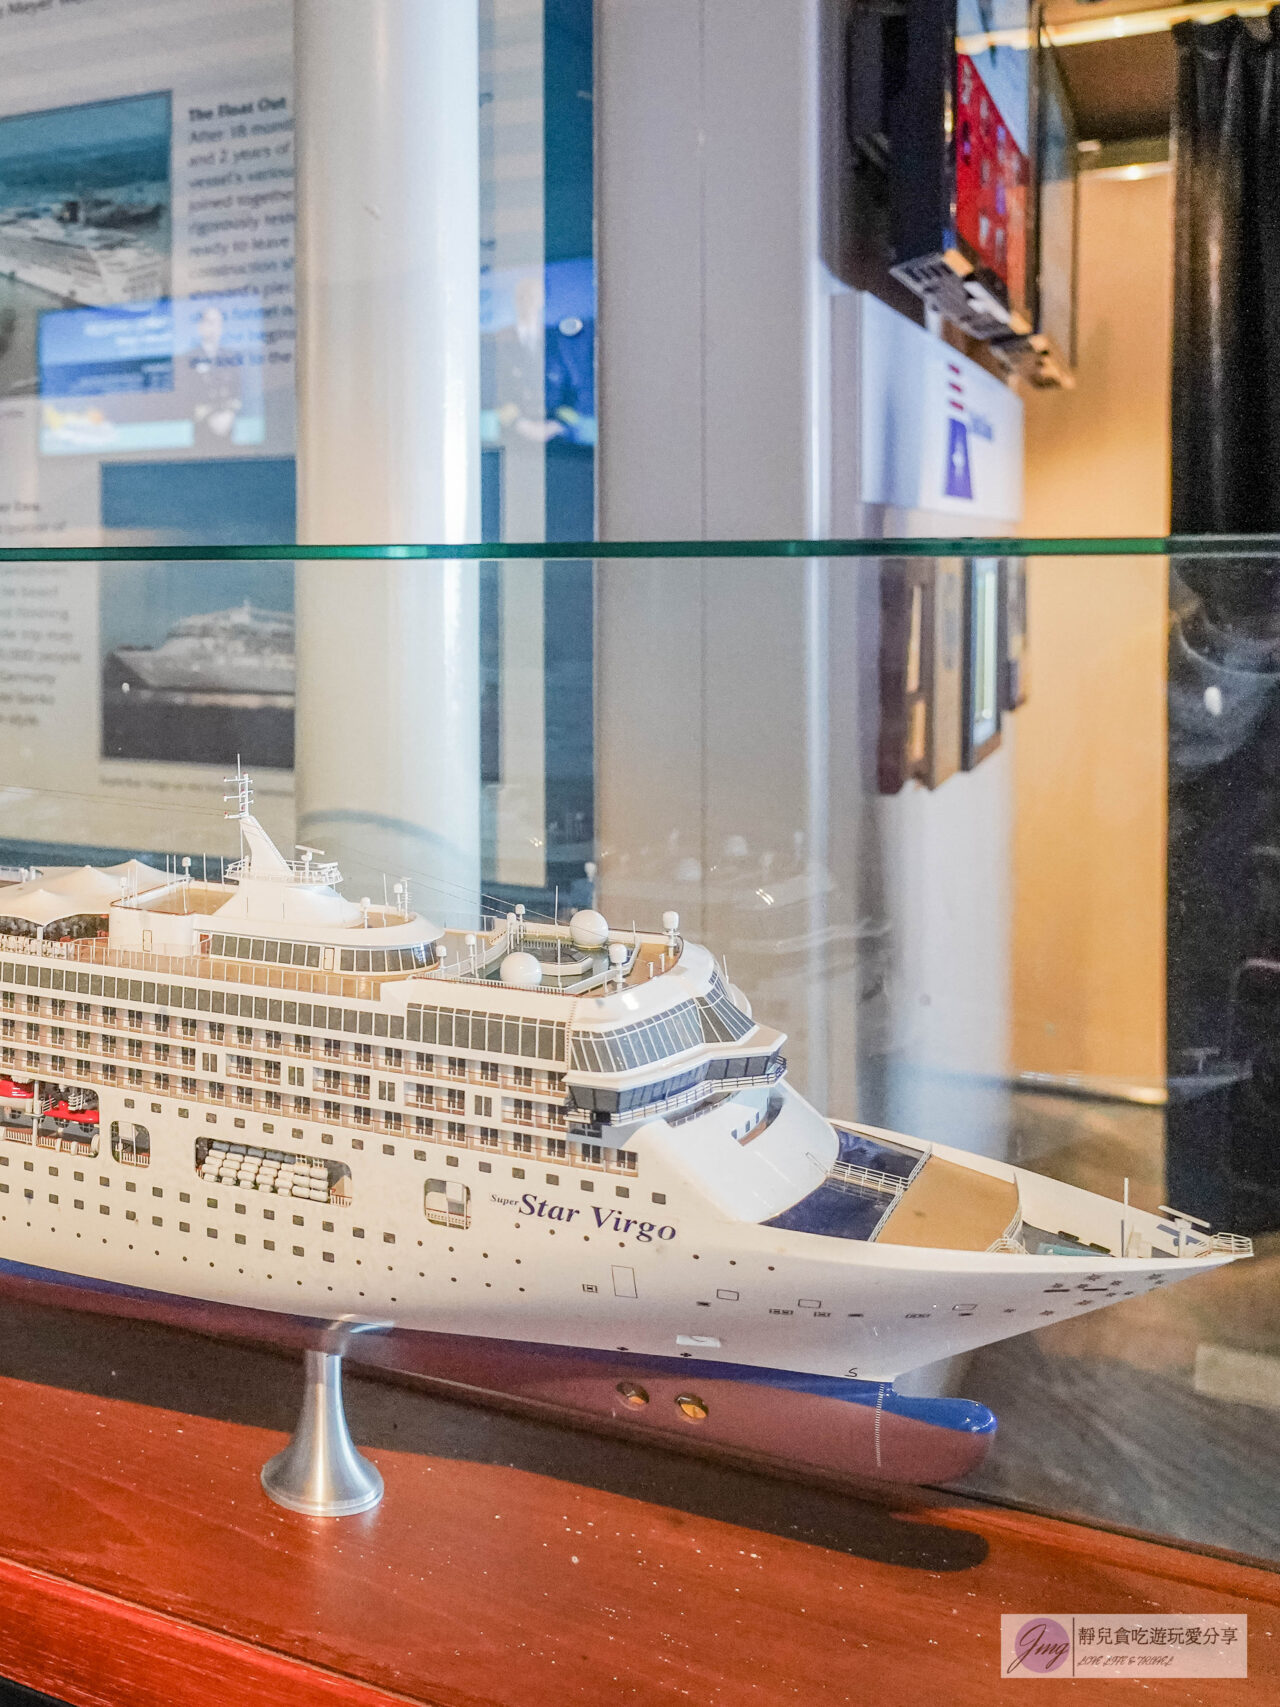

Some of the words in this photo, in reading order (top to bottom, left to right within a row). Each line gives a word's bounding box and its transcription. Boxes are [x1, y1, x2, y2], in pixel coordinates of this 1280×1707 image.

[489, 1193, 520, 1207] Super
[518, 1193, 580, 1223] Star
[590, 1205, 677, 1243] Virgo
